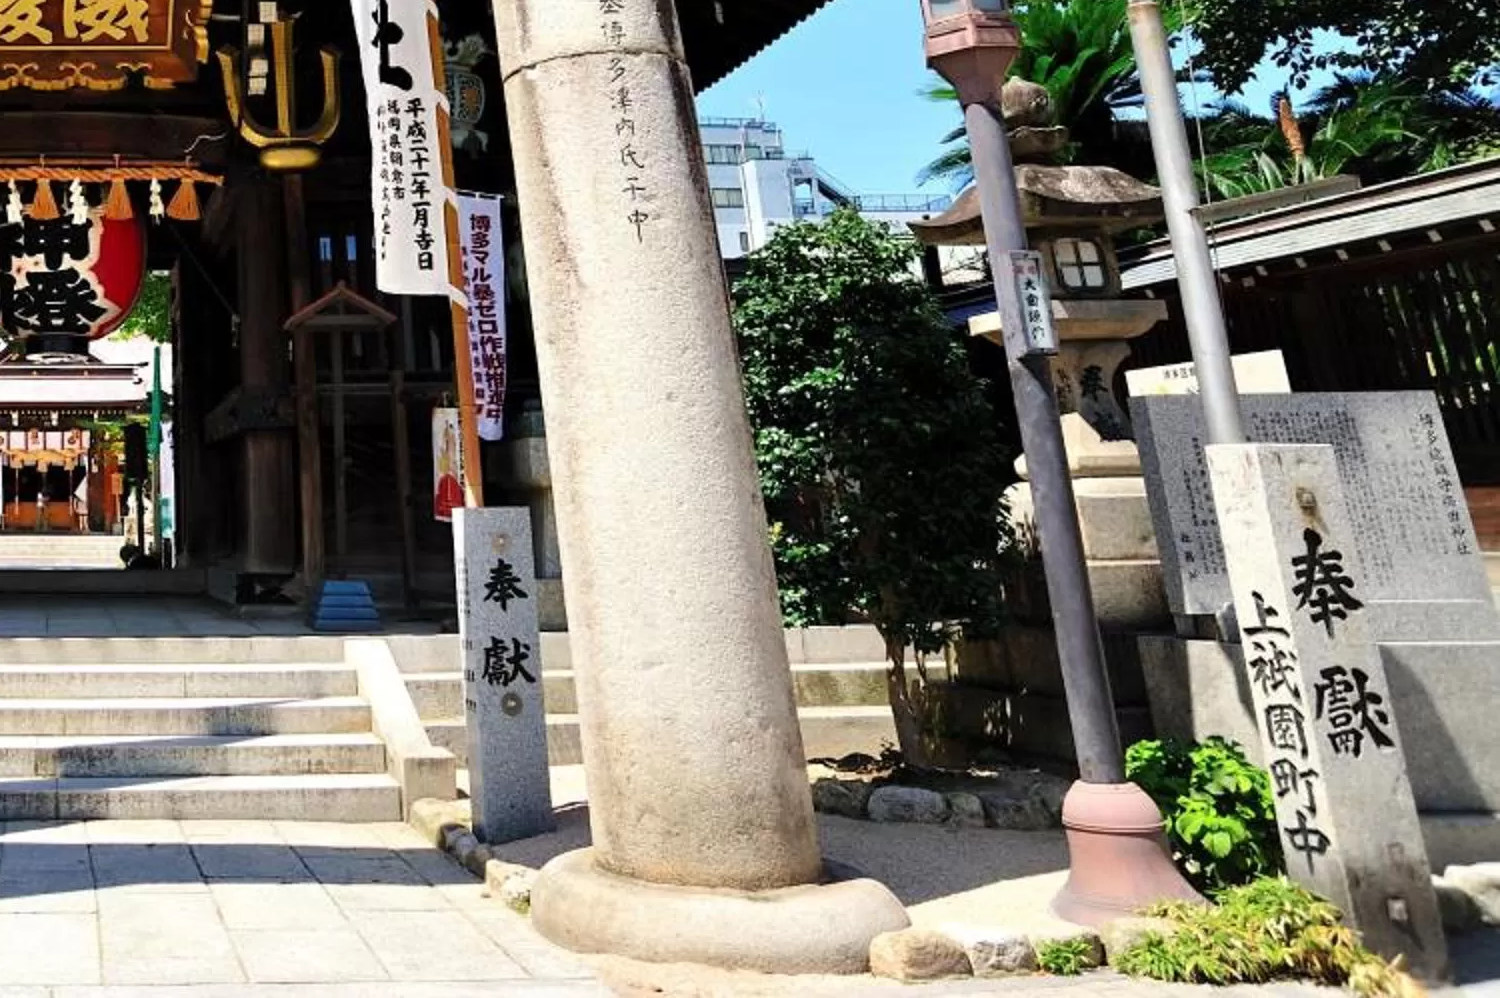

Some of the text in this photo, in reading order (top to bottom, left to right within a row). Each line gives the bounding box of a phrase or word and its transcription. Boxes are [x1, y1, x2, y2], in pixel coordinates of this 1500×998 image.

[404, 98, 434, 271] 平成二十一年一月吉日
